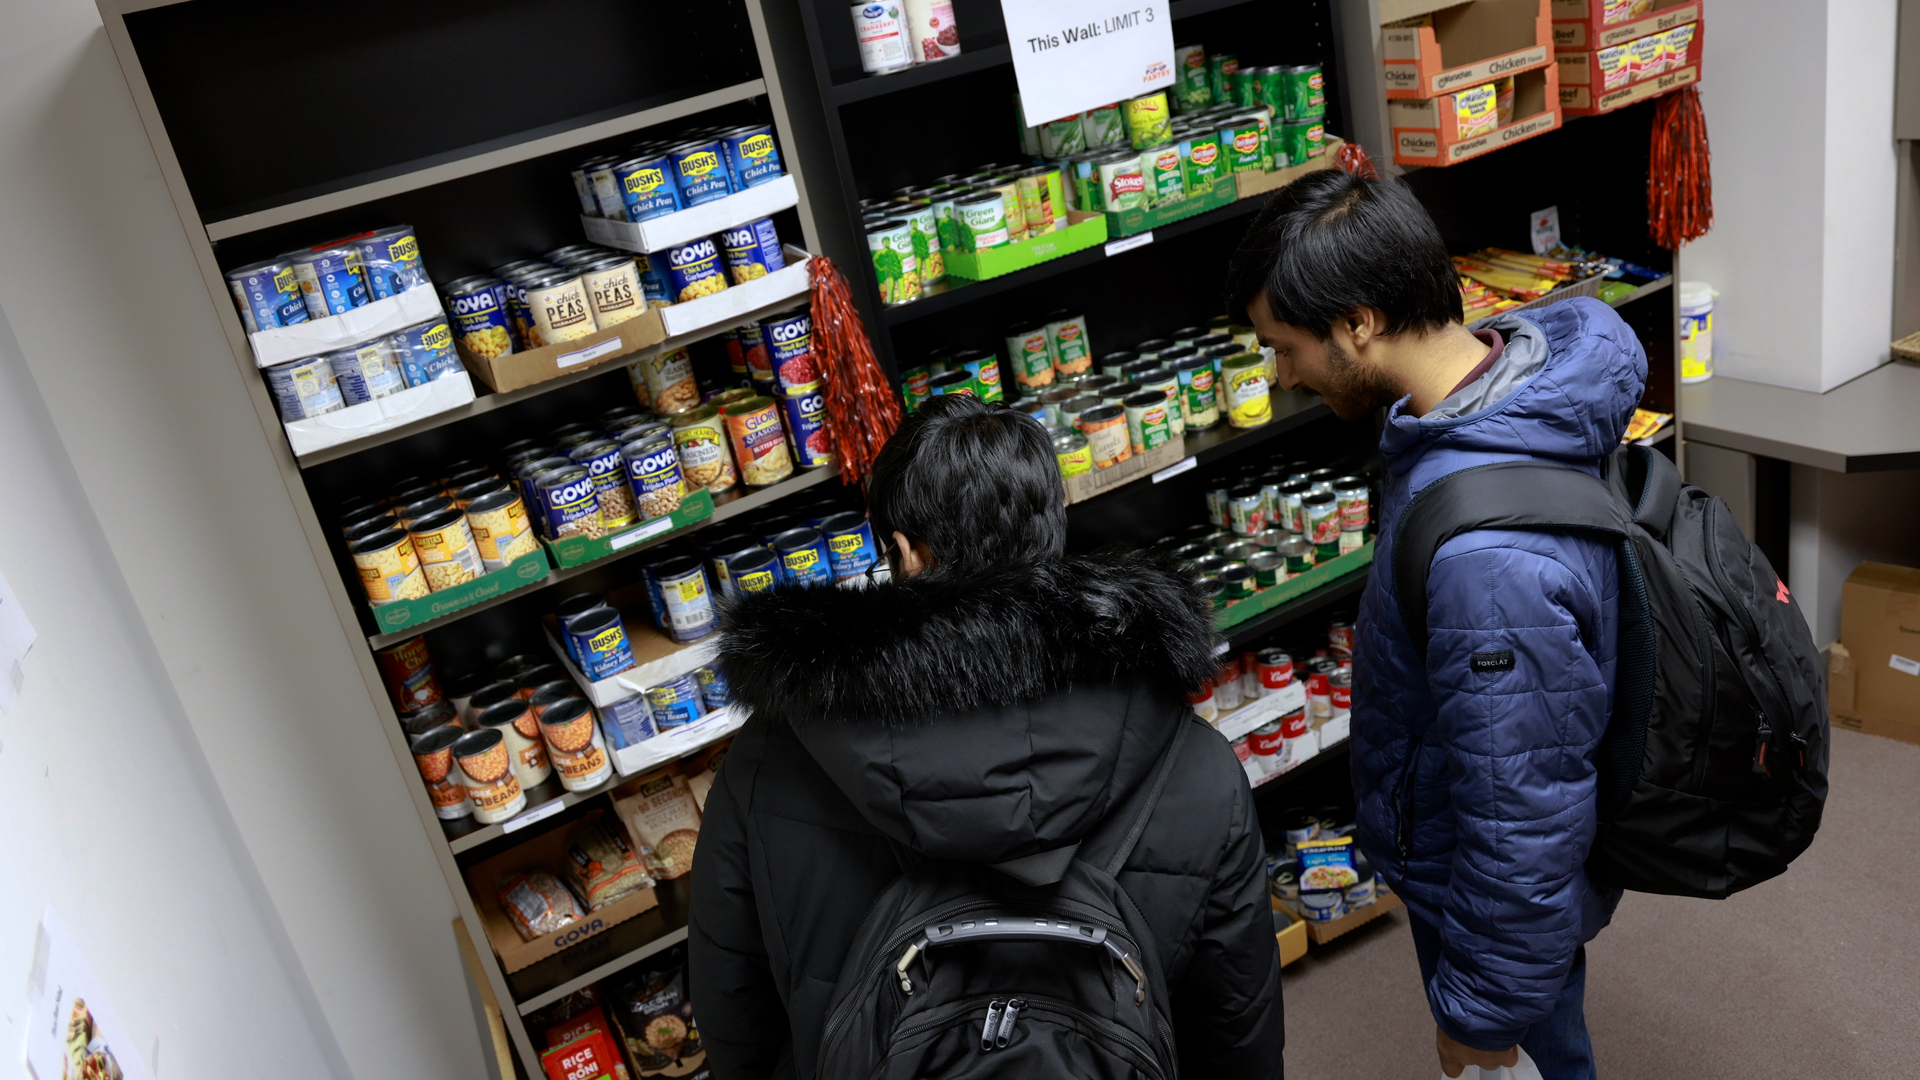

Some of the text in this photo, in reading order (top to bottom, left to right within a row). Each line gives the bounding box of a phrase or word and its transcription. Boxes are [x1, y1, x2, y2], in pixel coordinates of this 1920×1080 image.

[860, 20, 895, 32] CRANBERRY
[1027, 7, 1155, 53] This Wall: LIMIT 3
[1555, 29, 1575, 38] Beef
[1606, 27, 1636, 44] Maruchan
[1658, 14, 1676, 28] Beef
[1142, 69, 1171, 83] PANTRY
[1438, 70, 1472, 88] Maruchan
[1489, 58, 1526, 74] Chicken
[1460, 90, 1494, 108] Maruchan
[1602, 89, 1632, 107] Maruchan
[1658, 75, 1676, 88] Beef
[741, 136, 773, 156] BUSH'S
[1401, 138, 1436, 148] Chicken
[1454, 138, 1487, 156] Maruchan
[1503, 123, 1536, 140] Chicken
[681, 155, 717, 174] BUSH'S
[626, 172, 662, 192] BUSH'S
[744, 167, 768, 180] Chick
[686, 180, 726, 197] Chick Peas
[632, 196, 672, 214] Chick Peas
[966, 207, 994, 218] Green
[971, 215, 996, 226] Giant
[722, 230, 754, 247] OYA
[898, 240, 912, 250] Gia
[670, 240, 716, 264] GOYA
[683, 261, 714, 274] Chick Peas
[604, 275, 628, 290] chick
[557, 291, 580, 304] chick
[594, 285, 632, 306] PEAS
[451, 294, 494, 315] GOYA
[546, 299, 584, 321] PEAS
[801, 395, 824, 412] GO
[682, 446, 716, 460] EASONED
[754, 440, 773, 453] BUTTER
[1093, 437, 1120, 454] Carrots
[632, 448, 675, 475] GOYA
[700, 454, 718, 462] Beans
[644, 470, 675, 484] Pinto Beans
[551, 477, 594, 504] GOYA
[594, 482, 612, 492] rijoles
[642, 482, 664, 492] Frijoles
[564, 500, 594, 514] Pinto Beans
[562, 511, 584, 522] Frijoles
[830, 536, 862, 552] BUSH'S
[786, 552, 818, 569] BUSH'S
[853, 558, 872, 568] Beans
[475, 582, 499, 598] Good
[740, 573, 771, 590] BUSH'S
[592, 629, 622, 650] BUSH'S
[393, 644, 425, 662] Horm
[594, 660, 618, 673] Kidney
[668, 712, 688, 721] Beans
[554, 758, 572, 766] PORK
[566, 756, 602, 774] BEANS
[433, 793, 459, 804] ANS
[486, 784, 519, 806] BEANS
[638, 788, 685, 814] 90 SECOND
[554, 919, 603, 947] GOYA
[563, 1022, 592, 1041] RICE
[562, 1048, 594, 1070] RICE
[568, 1062, 598, 1080] RONI
